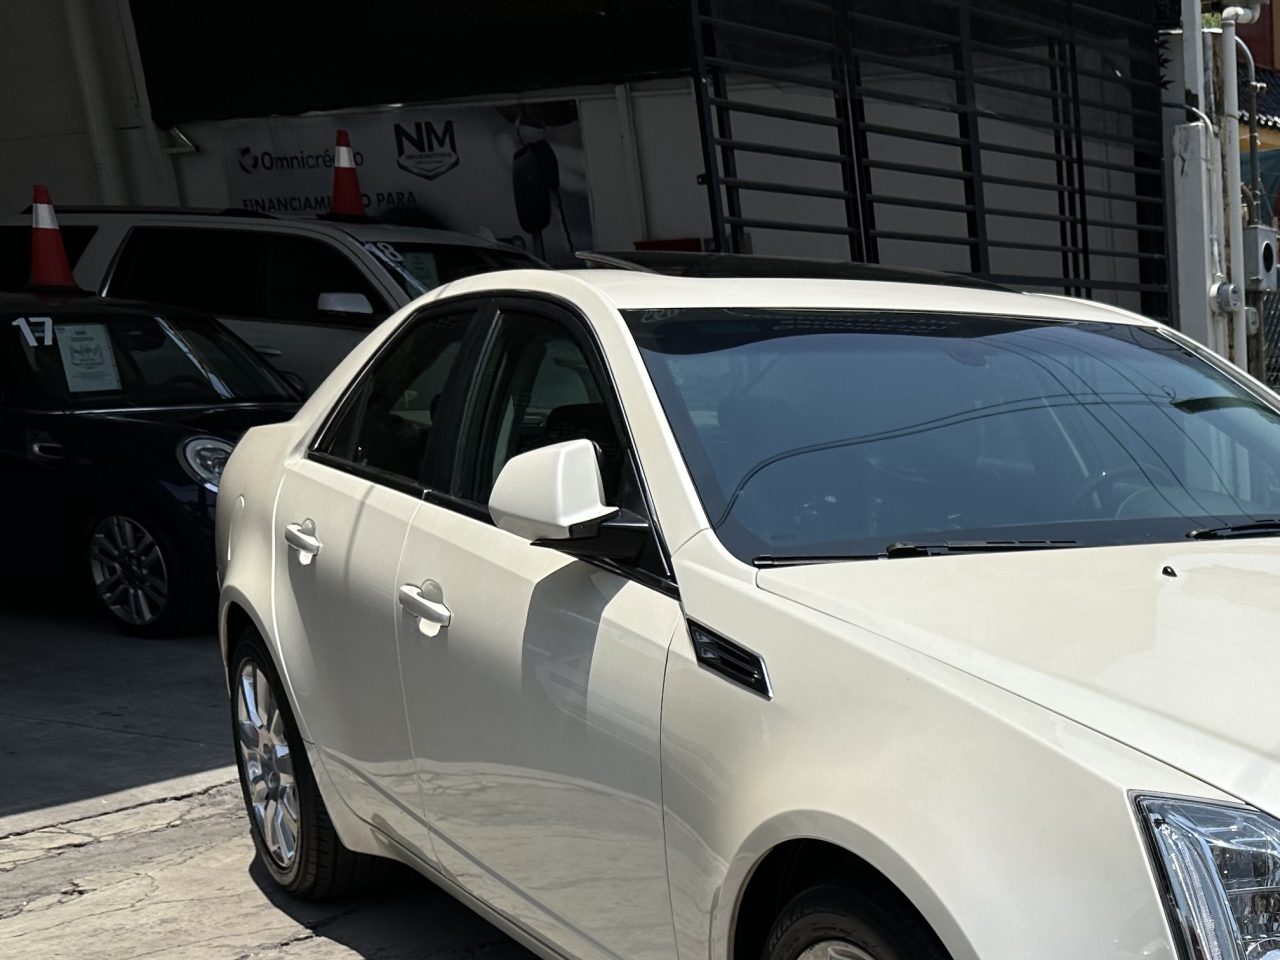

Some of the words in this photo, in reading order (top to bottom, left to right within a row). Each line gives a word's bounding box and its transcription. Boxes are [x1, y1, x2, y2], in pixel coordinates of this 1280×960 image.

[394, 120, 457, 158] NM
[261, 148, 364, 171] Omnicréo
[377, 191, 416, 207] PARA
[11, 316, 54, 347] 17
